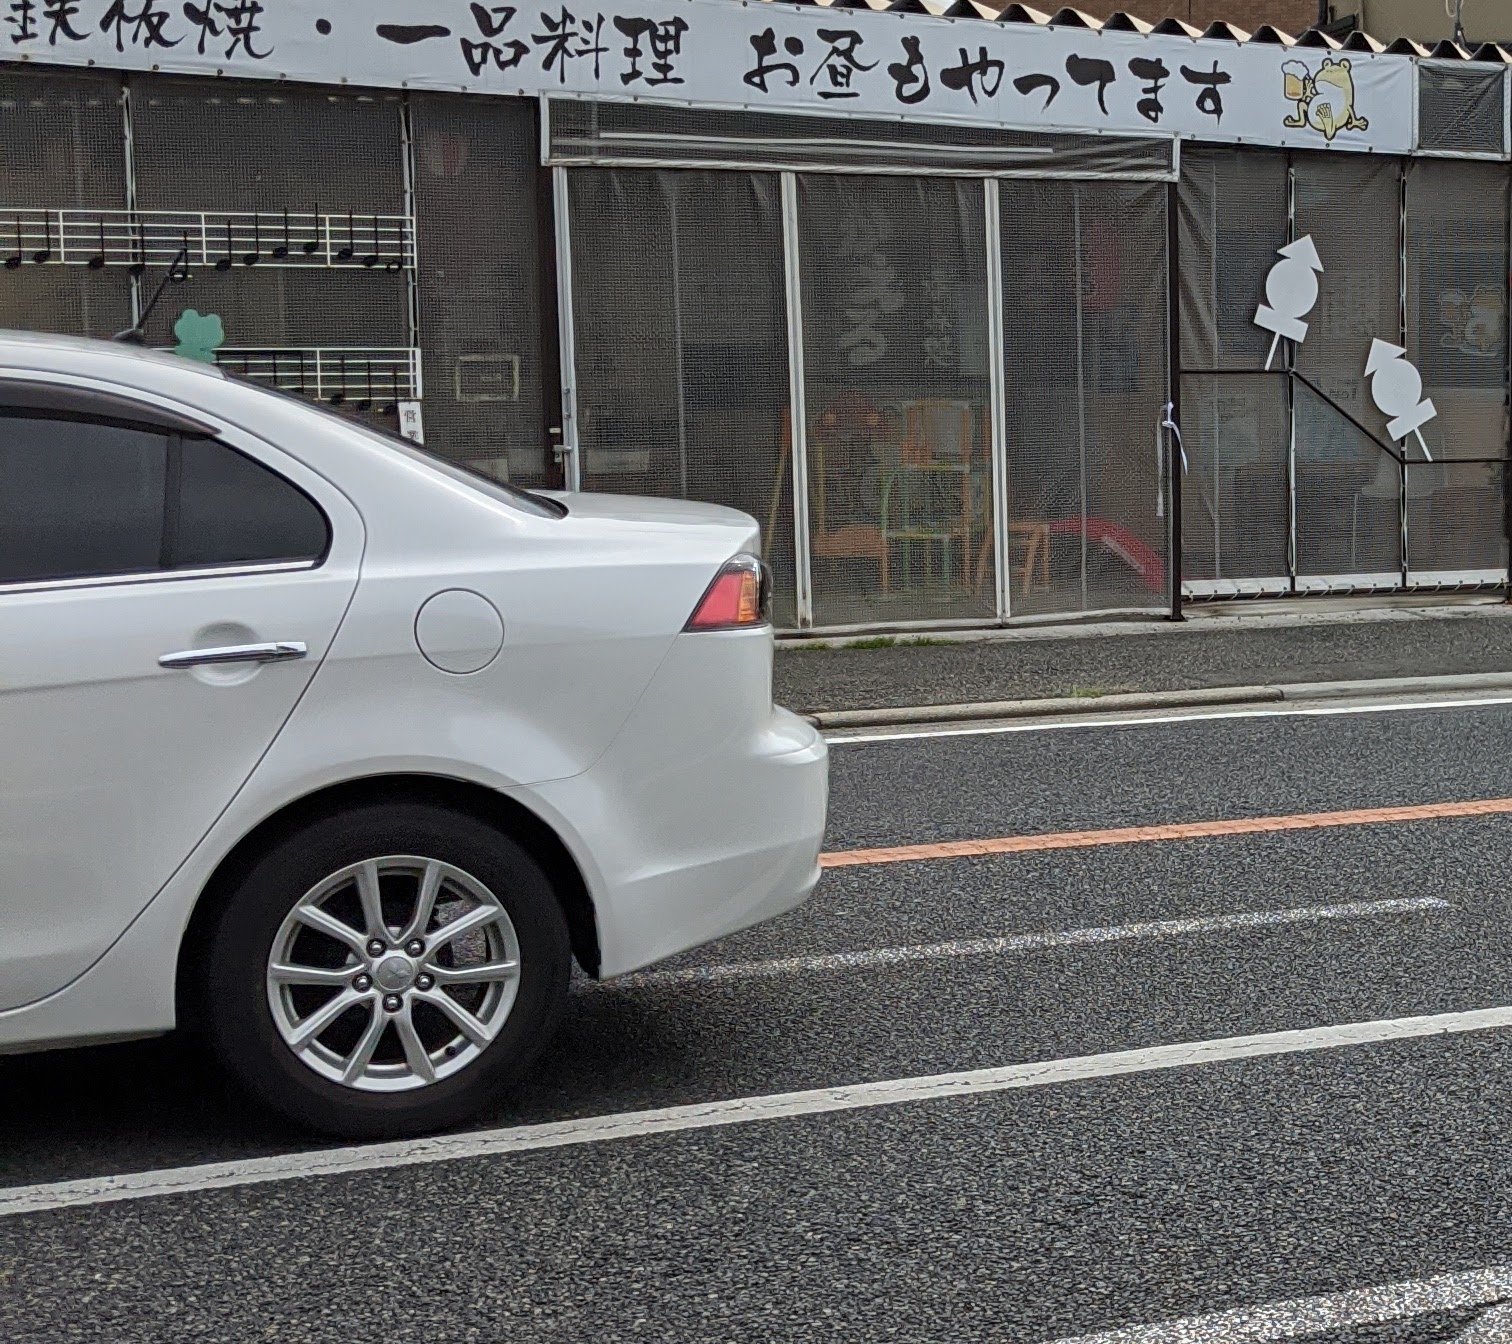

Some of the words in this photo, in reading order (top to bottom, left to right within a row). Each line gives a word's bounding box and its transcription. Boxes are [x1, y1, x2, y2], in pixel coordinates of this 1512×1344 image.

[742, 26, 1233, 125] お昼もやってます
